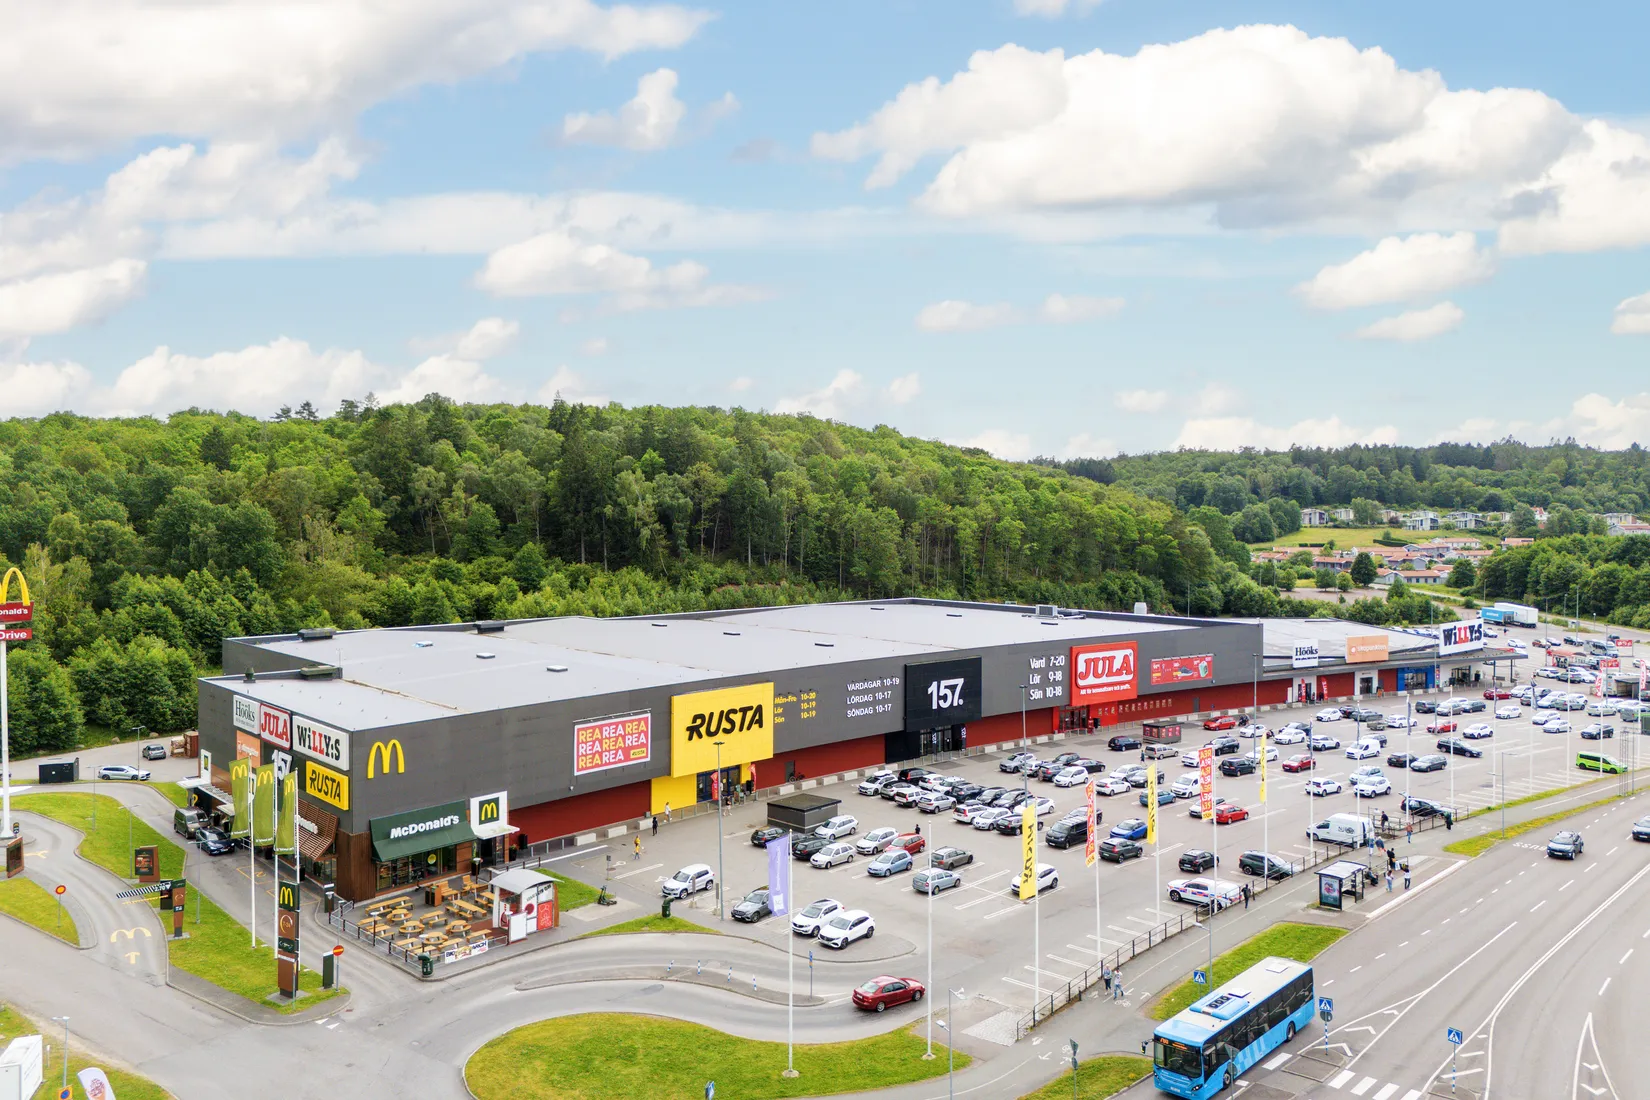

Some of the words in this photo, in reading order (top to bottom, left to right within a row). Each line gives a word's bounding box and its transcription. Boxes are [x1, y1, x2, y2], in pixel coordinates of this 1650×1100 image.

[1295, 646, 1318, 656] Hööks
[1030, 657, 1046, 669] Vard
[1050, 655, 1064, 666] 7-20
[1078, 654, 1132, 680] JULA
[847, 680, 881, 692] VARDAGAR
[884, 677, 900, 686] 10-19
[1030, 674, 1040, 684] Lör
[1048, 671, 1062, 682] 9-18
[846, 692, 873, 704] LÖRDAG
[875, 690, 892, 700] 10-17
[1030, 689, 1042, 700] Sön
[1046, 686, 1062, 698] 10-18
[236, 700, 255, 722] Hööks
[847, 706, 873, 718] SÖNDAG
[875, 704, 892, 713] 10-17
[262, 712, 289, 742] JULA
[579, 728, 601, 743] REA
[602, 724, 624, 738] REA
[625, 720, 646, 734] REA
[686, 704, 763, 741] RUSTA
[579, 740, 601, 756] REA
[602, 736, 624, 751] REA
[625, 732, 646, 747] REA
[579, 753, 601, 768] REA
[602, 749, 624, 764] REA
[310, 769, 341, 802] RUSTA
[390, 815, 459, 839] McDonald's
